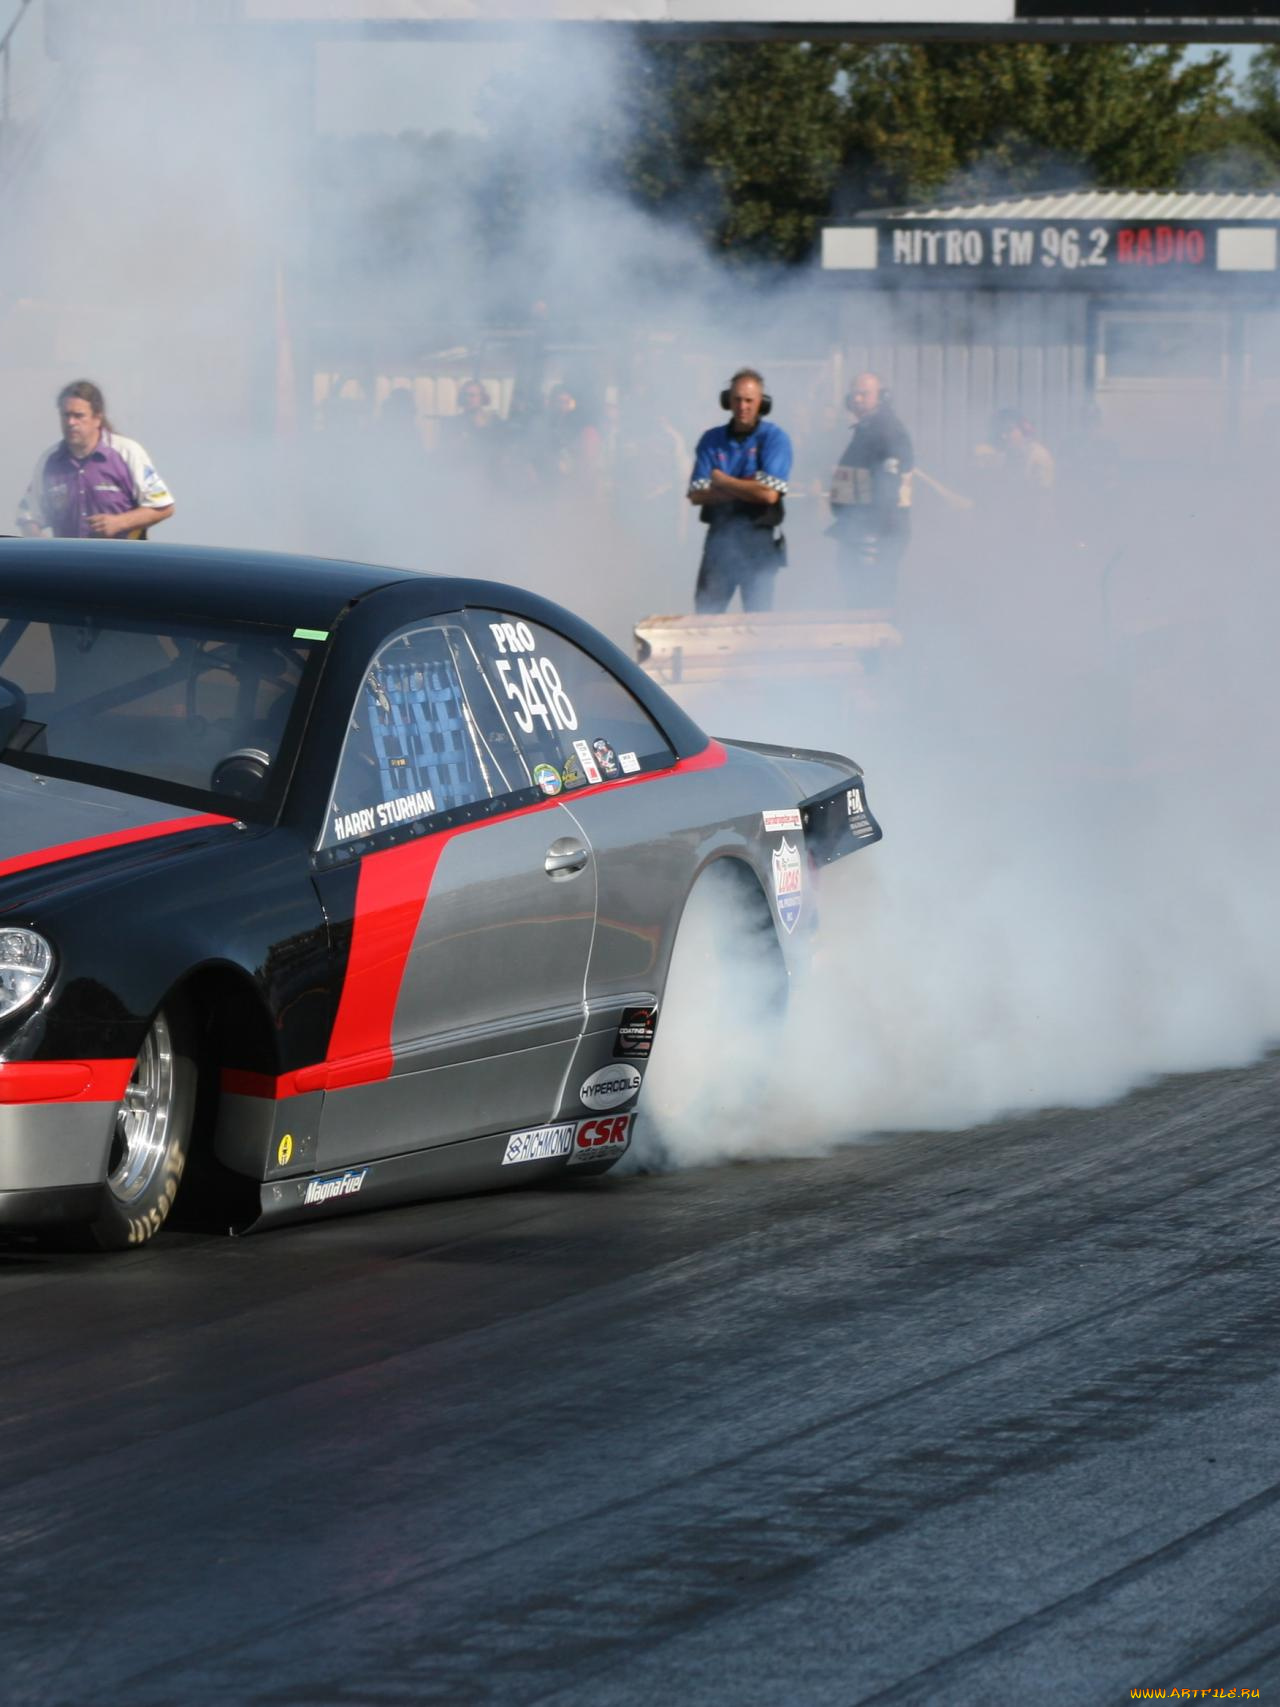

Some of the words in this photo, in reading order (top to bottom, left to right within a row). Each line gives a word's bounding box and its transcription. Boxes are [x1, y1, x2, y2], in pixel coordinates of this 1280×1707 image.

[892, 228, 984, 265] NITRO
[992, 228, 1034, 265] FM
[1040, 227, 1110, 268] 96.2
[1116, 225, 1206, 266] RADIO
[489, 621, 536, 654] PRO
[495, 657, 578, 733] 5418
[334, 807, 376, 840] HARRY
[376, 790, 436, 827] STURHAN
[581, 1076, 640, 1098] HYPERCOILS
[520, 1127, 574, 1159] RICHMOND
[576, 1115, 629, 1148] CSR
[304, 1169, 367, 1205] MagnaFuel
